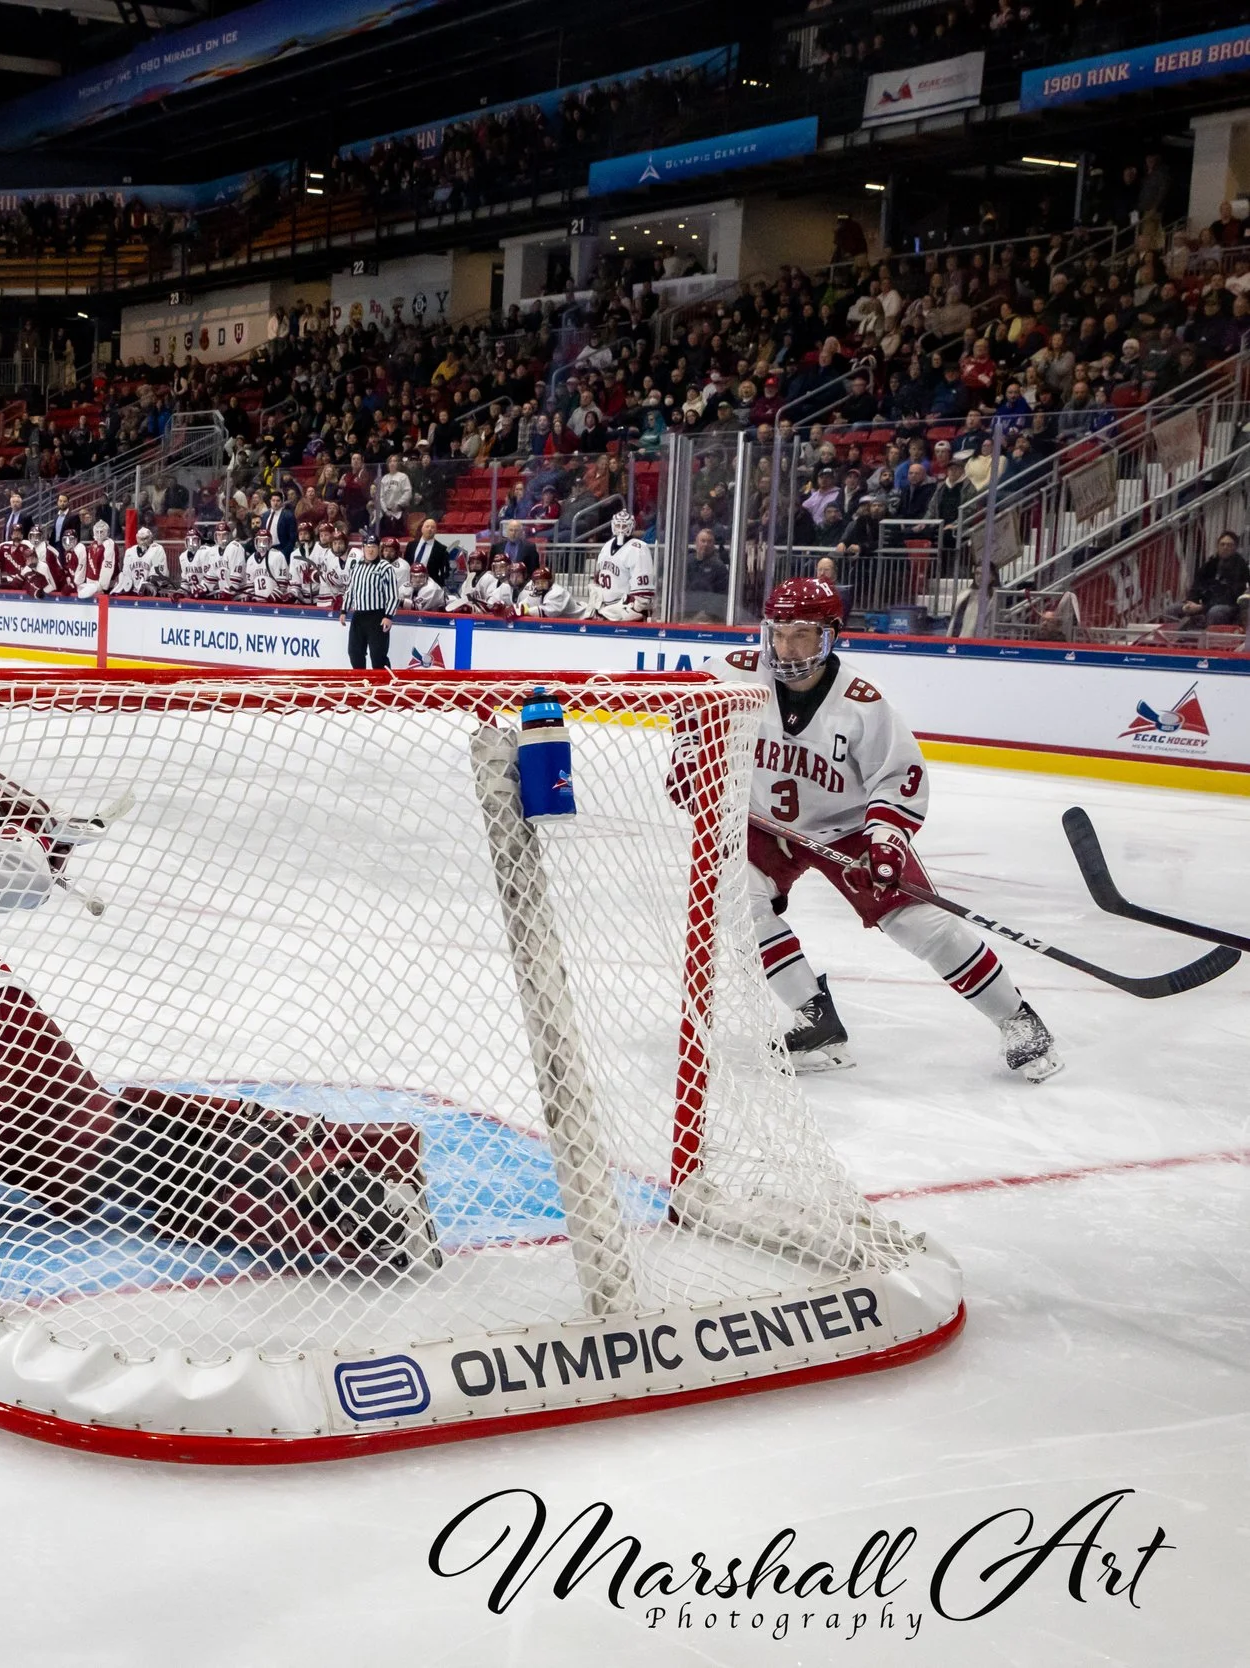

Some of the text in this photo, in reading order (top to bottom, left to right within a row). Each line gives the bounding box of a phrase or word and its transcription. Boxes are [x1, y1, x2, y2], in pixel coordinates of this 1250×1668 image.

[135, 57, 161, 75] 1980
[163, 43, 203, 65] MIRACLE
[205, 38, 219, 51] ON
[222, 30, 239, 45] ICE
[1043, 72, 1082, 96] 1980
[1086, 62, 1131, 87] RINK
[1154, 47, 1203, 74] HERB
[665, 143, 758, 170] OLYMPIC CENTER
[570, 218, 585, 235] 21
[353, 260, 365, 275] 22
[170, 292, 180, 305] 23
[134, 569, 145, 581] 35
[257, 578, 267, 591] 12
[600, 573, 612, 590] 30
[636, 575, 649, 586] 30
[20, 617, 98, 638] CHAMPIONSHIP
[161, 627, 320, 658] LAKE PLACID, NEW YORK
[832, 734, 847, 763] C
[1133, 733, 1208, 748] ECAC HOCKEY
[753, 737, 845, 794] ARVARD
[900, 765, 924, 798] 3
[770, 778, 800, 823] 3
[800, 838, 855, 868] JETSP
[965, 910, 1051, 954] CCM
[450, 1286, 883, 1398] OLYMPIC CENTER
